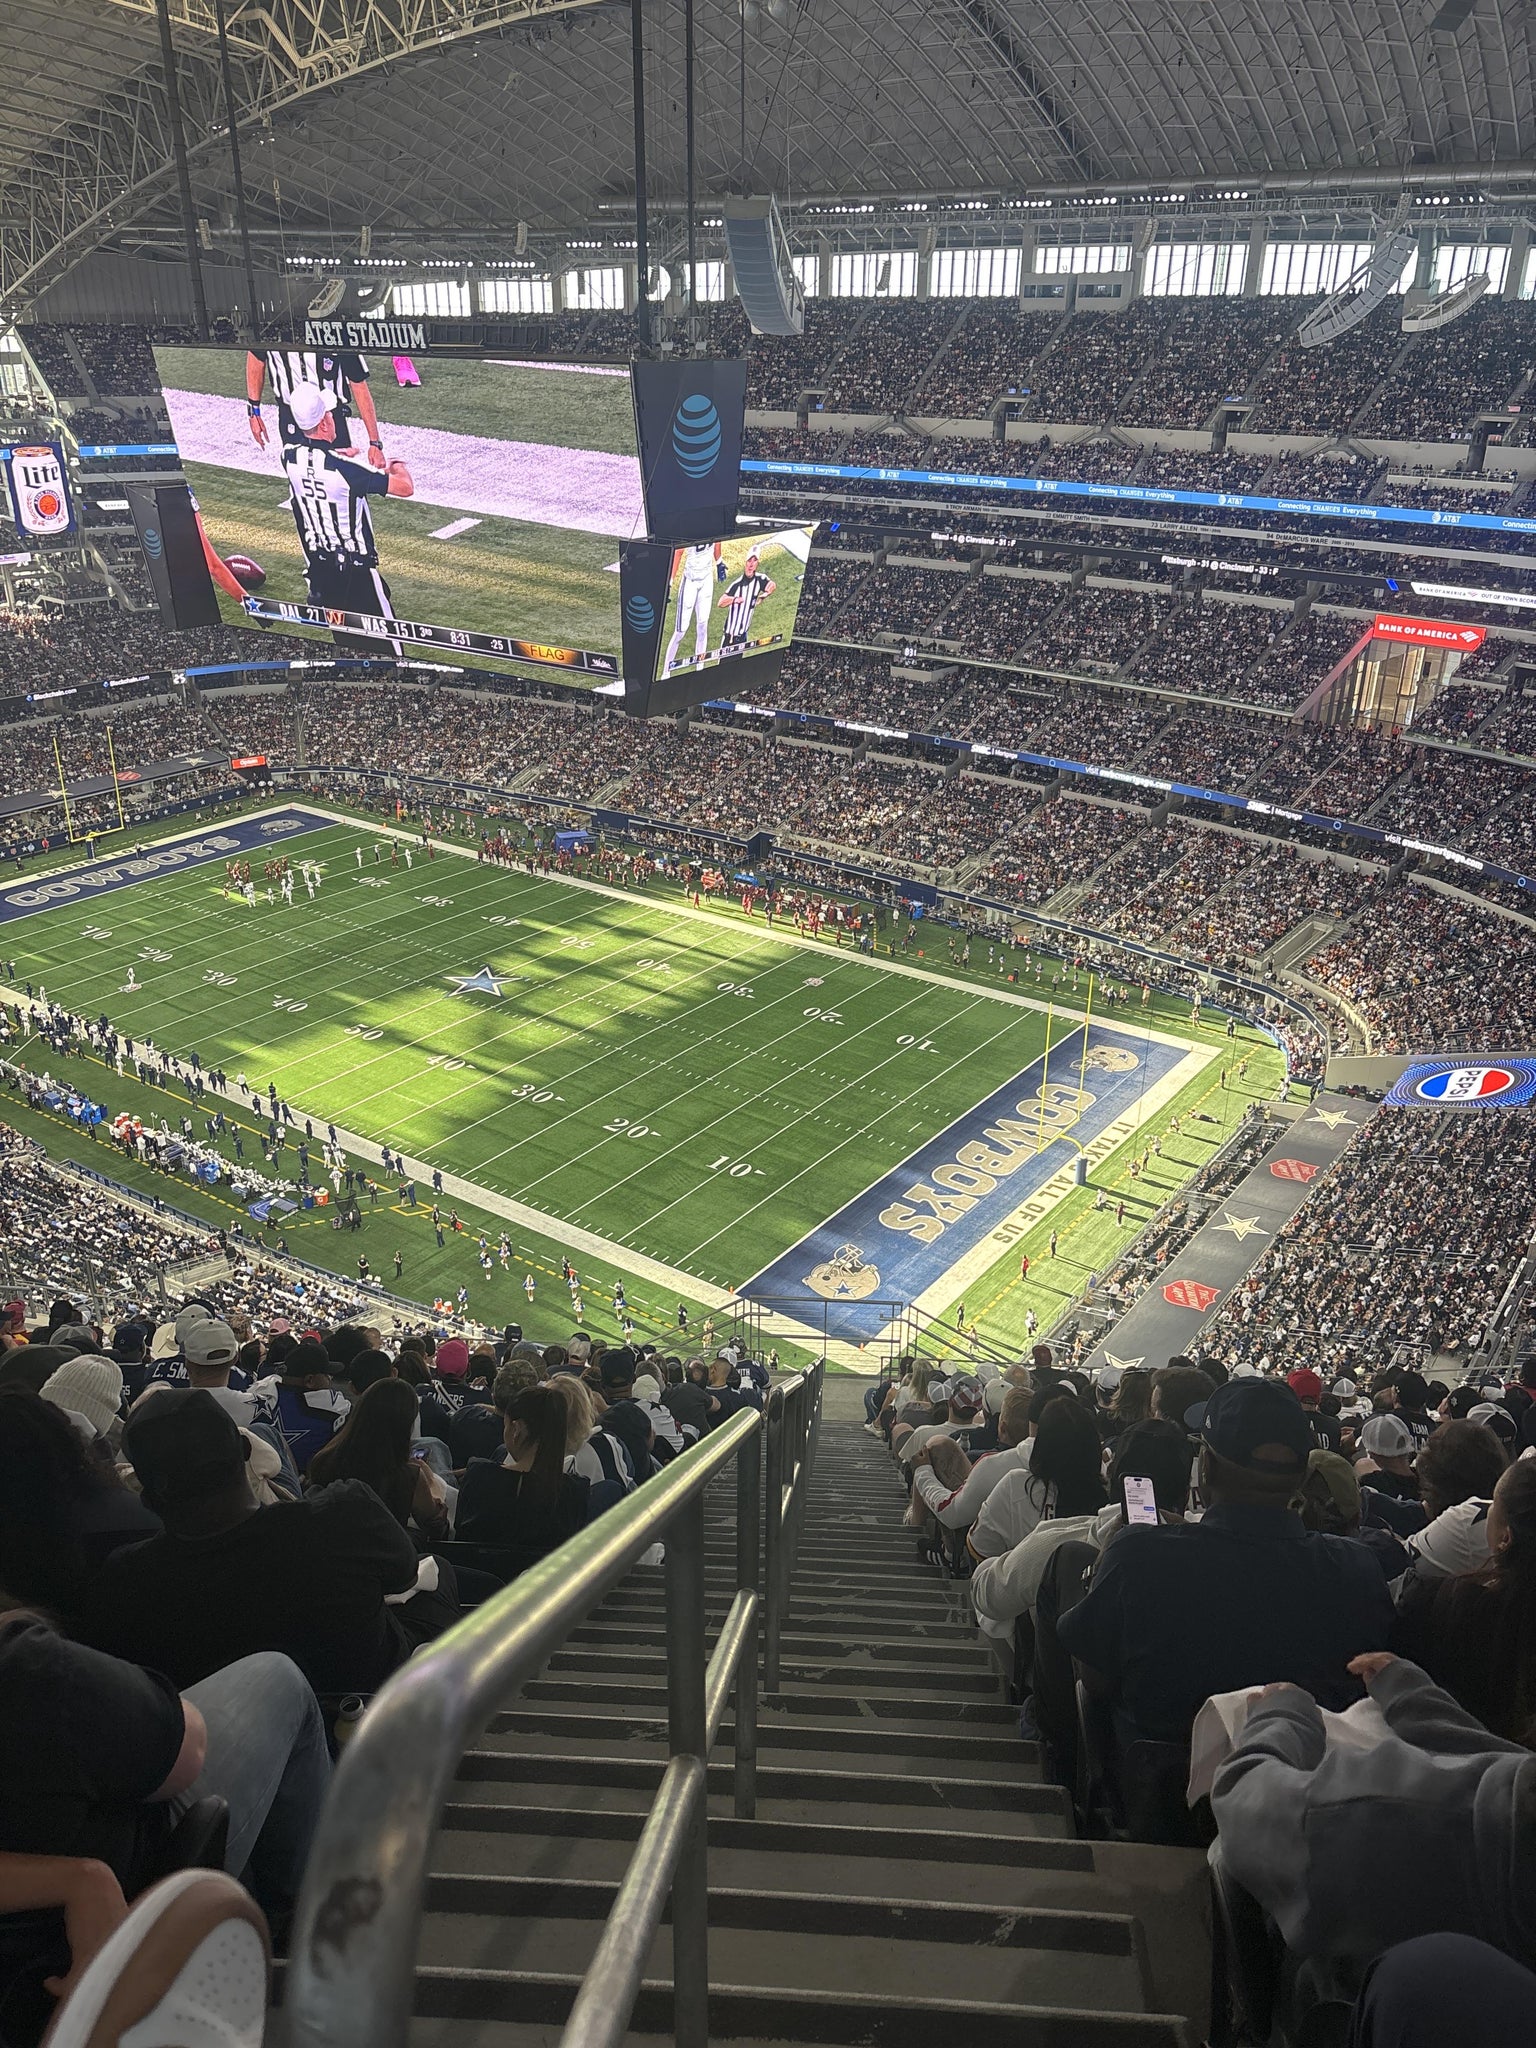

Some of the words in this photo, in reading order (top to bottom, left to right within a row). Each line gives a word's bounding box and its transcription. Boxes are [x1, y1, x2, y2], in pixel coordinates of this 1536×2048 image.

[305, 321, 343, 346] AT&T
[346, 322, 427, 349] STADIUM
[20, 465, 59, 489] Lite
[307, 468, 316, 479] R
[767, 463, 792, 472] Connecting
[815, 467, 840, 475] Everything
[886, 471, 900, 479] AT&T
[301, 478, 327, 500] 55
[928, 474, 955, 483] Connecting
[980, 479, 1007, 488] Everything
[1088, 486, 1118, 496] Connecting
[1145, 490, 1175, 500] Everything
[1226, 497, 1243, 505] AT&T
[1278, 501, 1311, 512] Connecting
[1313, 505, 1340, 513] CHANGES
[1342, 507, 1377, 518] Everything
[1441, 514, 1461, 523] AT&T
[966, 536, 994, 546] Cleveland
[1161, 555, 1197, 567] Pittsburgh
[1220, 562, 1254, 573] Cincinnati
[1441, 589, 1466, 597] AMERICA
[279, 602, 302, 620] DAL
[306, 607, 320, 622] 27
[361, 616, 388, 634] WAS
[394, 621, 408, 638] 15
[1379, 623, 1403, 633] BANK
[1404, 626, 1417, 635] OF
[1417, 628, 1458, 641] AMERICA
[419, 627, 433, 638] 3RD
[450, 631, 471, 646] 8:31
[490, 639, 504, 651] :25
[530, 644, 565, 661] FLAG
[33, 688, 77, 700] Blockchain.com
[1275, 808, 1303, 820] Mortgage
[1385, 833, 1401, 844] visit
[5, 835, 240, 907] COWBOYS
[421, 895, 454, 907] 30
[489, 915, 521, 926] 40
[80, 926, 113, 940] 10
[560, 936, 595, 950] 50
[137, 947, 173, 962] 20
[202, 970, 238, 986] 30
[717, 982, 755, 997] 30
[271, 996, 308, 1012] 40
[803, 1007, 843, 1023] 20
[343, 1023, 384, 1041] 50
[896, 1034, 937, 1051] 10
[426, 1055, 466, 1071] 40
[1446, 1070, 1482, 1098] PEPSI
[511, 1084, 554, 1103] 30
[602, 1118, 650, 1138] 20
[1112, 1121, 1135, 1136] IT
[705, 1155, 752, 1177] 10
[879, 1083, 1096, 1243] COWBOYS
[1038, 1175, 1074, 1199] ALL
[1021, 1202, 1045, 1222] OF
[992, 1223, 1024, 1244] US
